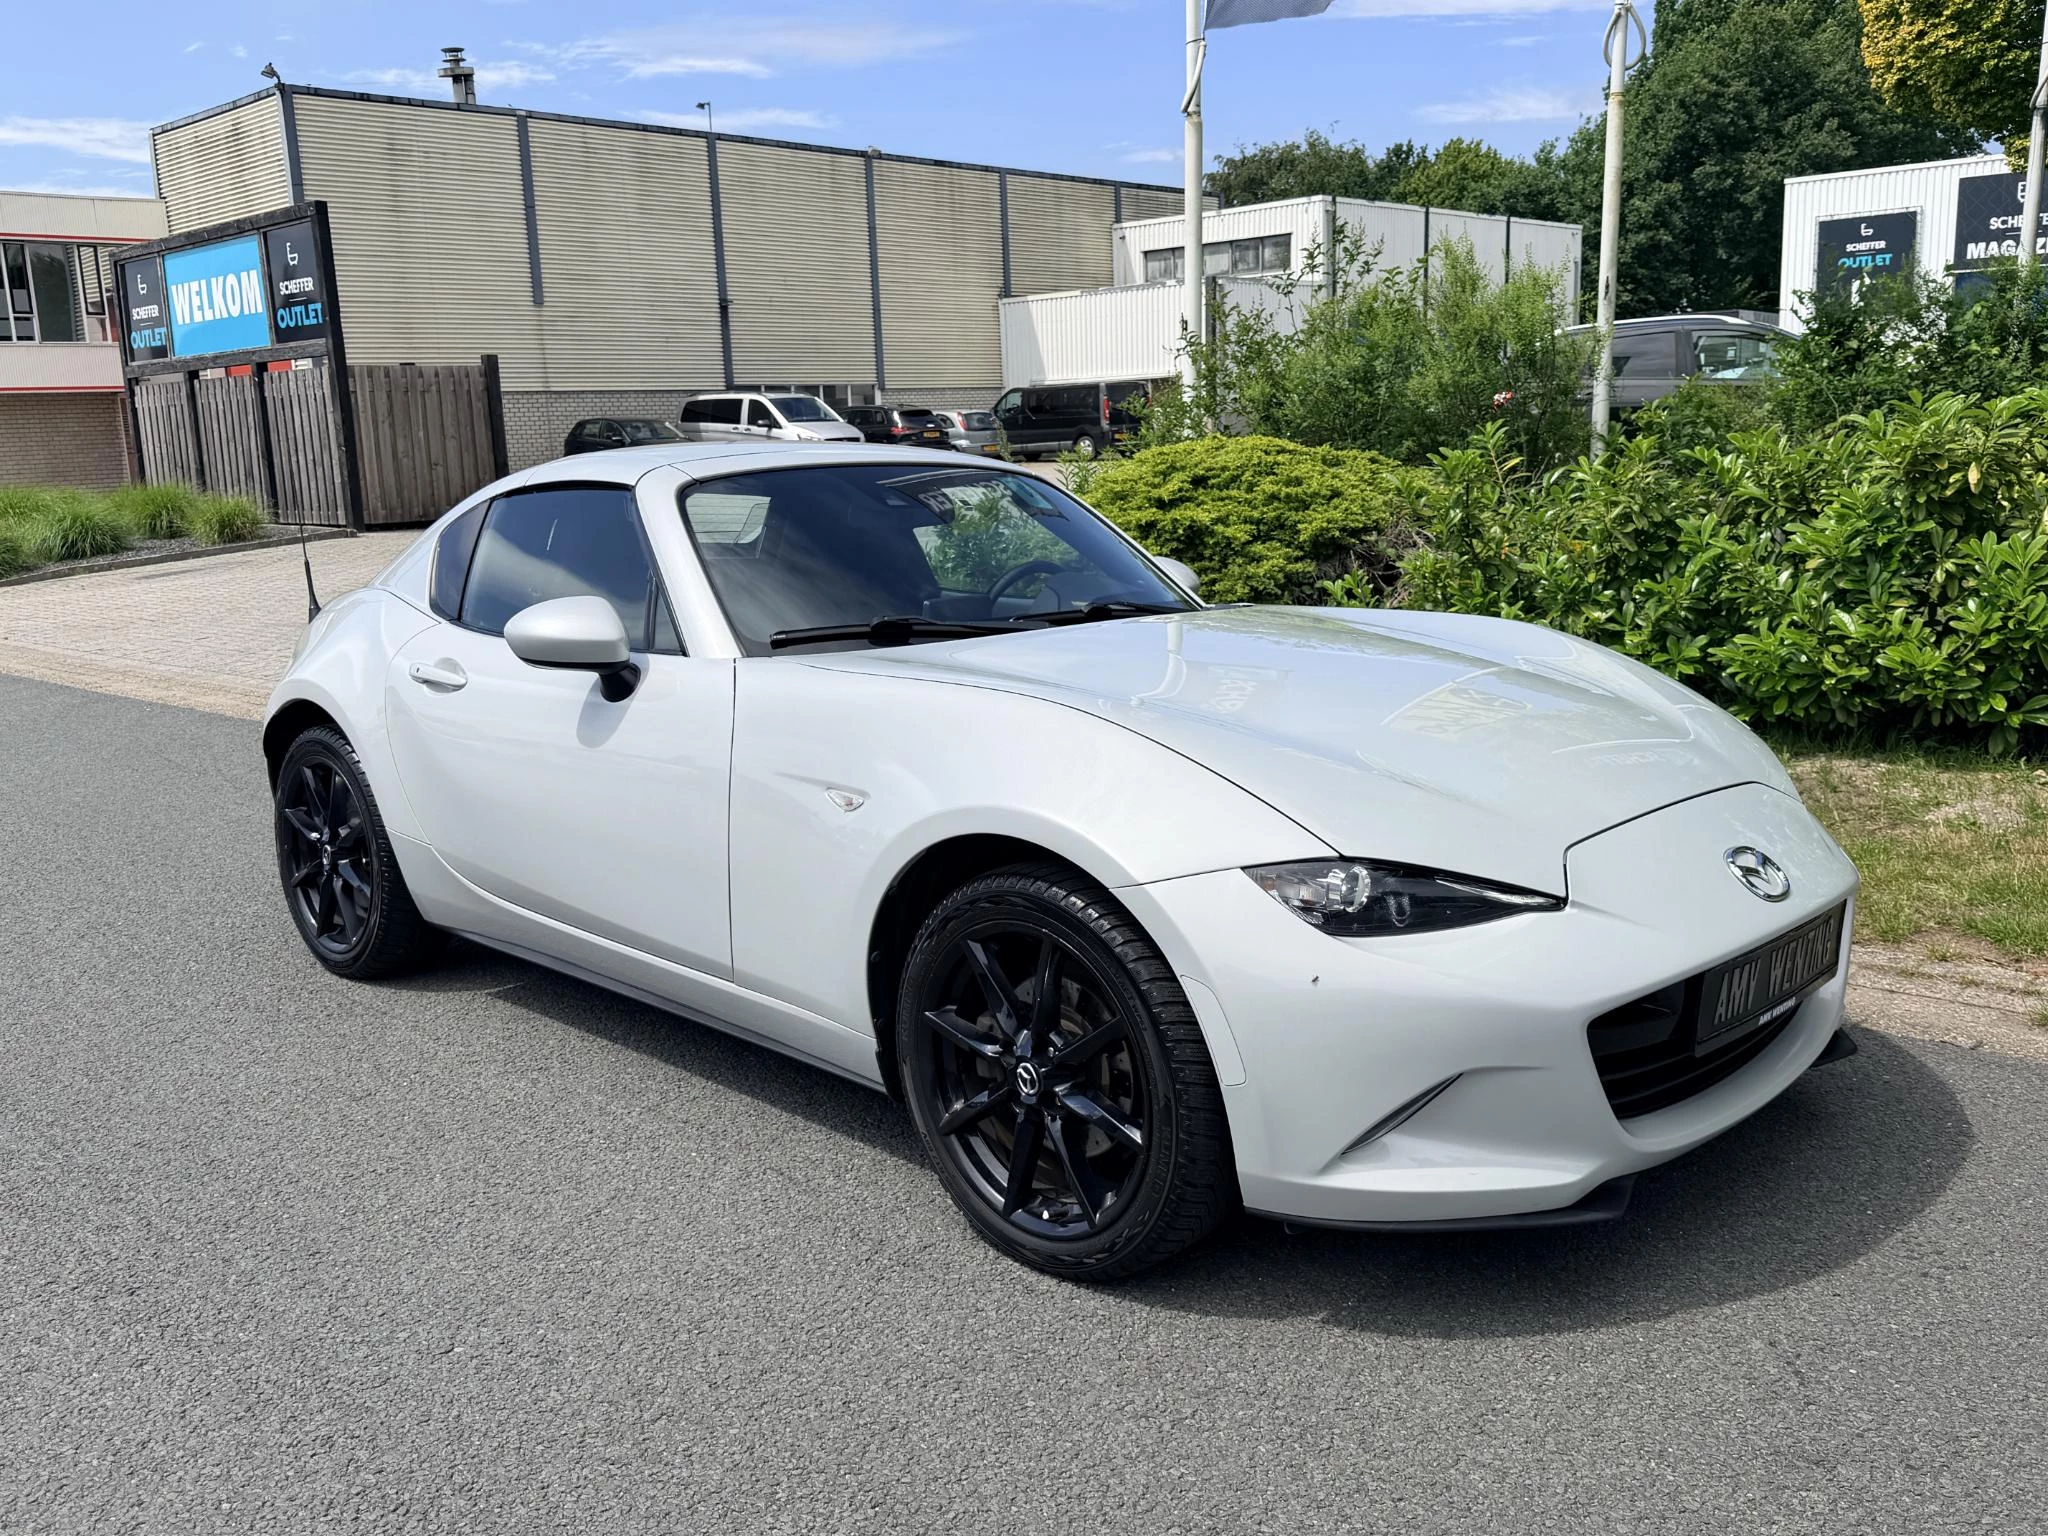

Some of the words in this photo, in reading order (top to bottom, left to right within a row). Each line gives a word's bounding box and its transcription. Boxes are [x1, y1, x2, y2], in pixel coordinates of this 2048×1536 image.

[1989, 211, 2048, 231] SCHEE
[1845, 240, 1887, 252] SCHEFFER
[1837, 253, 1893, 268] OUTLET
[279, 276, 315, 296] SCHEFFER
[171, 270, 263, 325] WELKOM
[132, 304, 160, 321] SCHEFFER
[277, 302, 323, 329] OUTLET
[130, 327, 167, 349] OUTLET
[1768, 915, 1834, 999] WENTING
